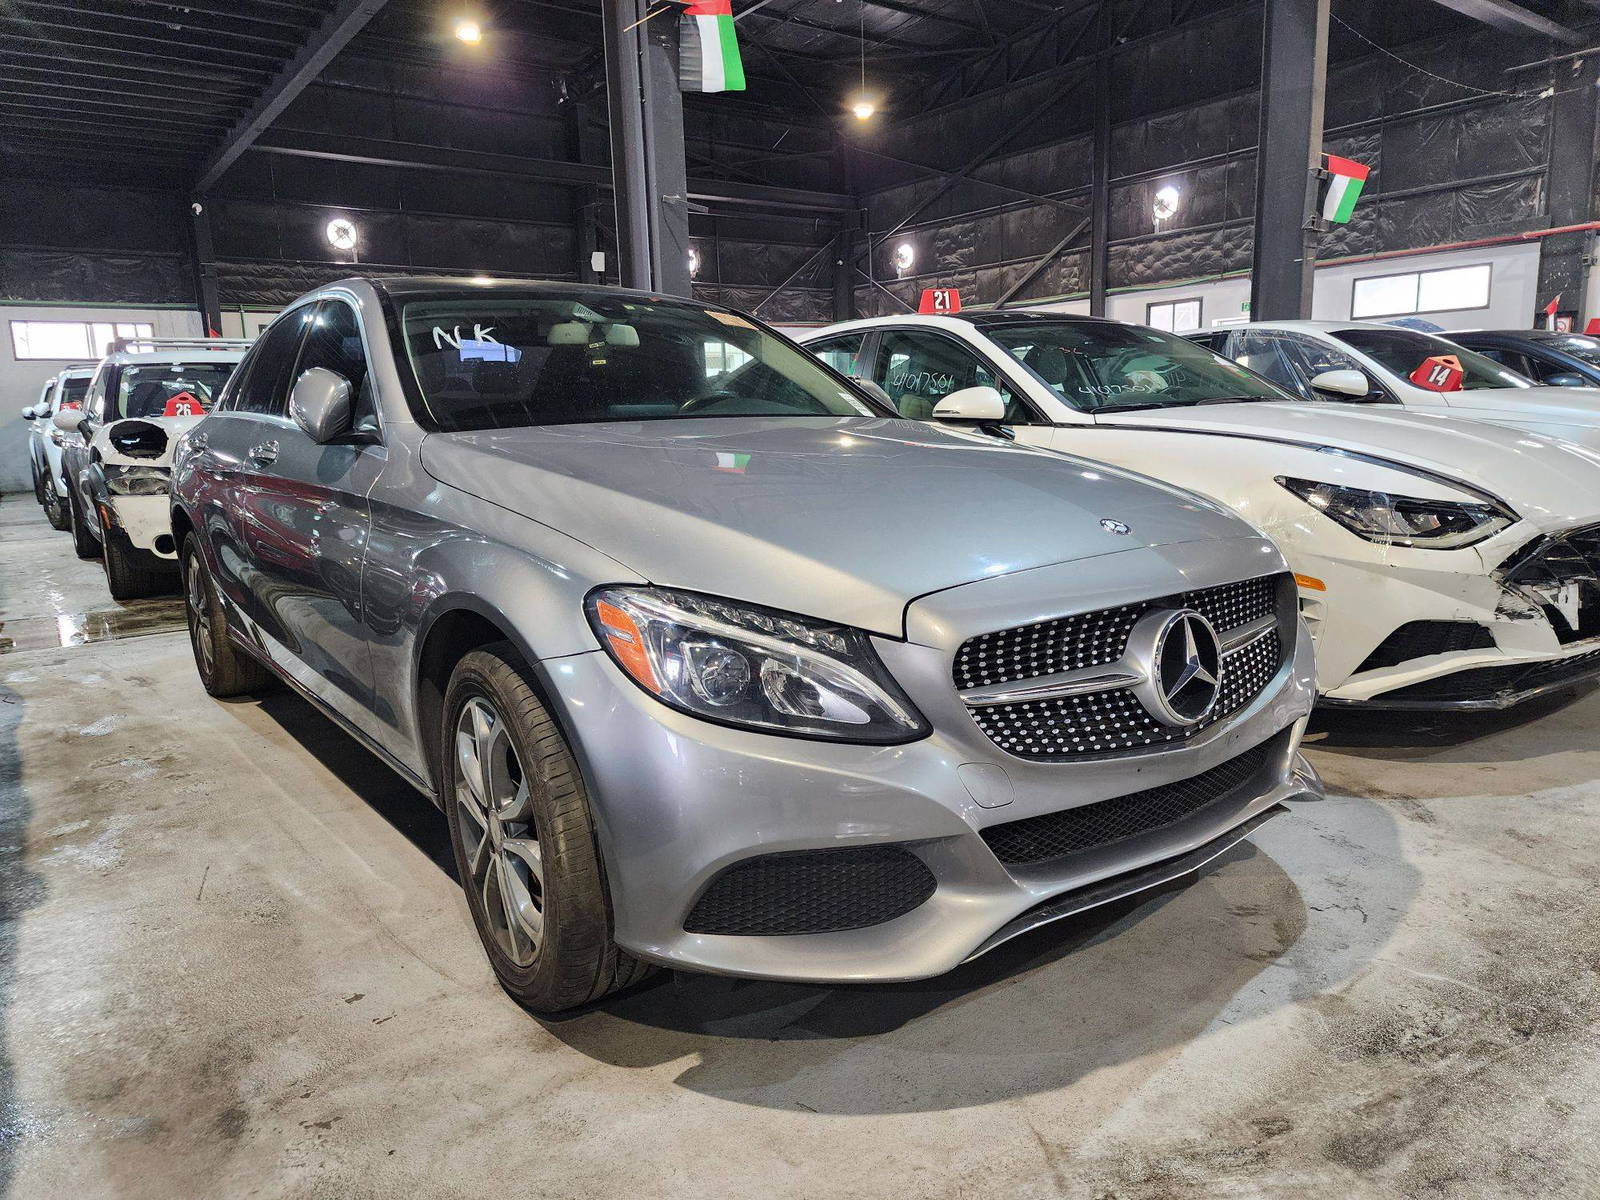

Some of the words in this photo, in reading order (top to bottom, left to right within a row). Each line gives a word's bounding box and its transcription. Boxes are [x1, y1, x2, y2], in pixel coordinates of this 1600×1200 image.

[934, 291, 951, 310] 21
[892, 371, 954, 393] 41017501
[1428, 365, 1452, 386] 14
[175, 403, 192, 417] 26
